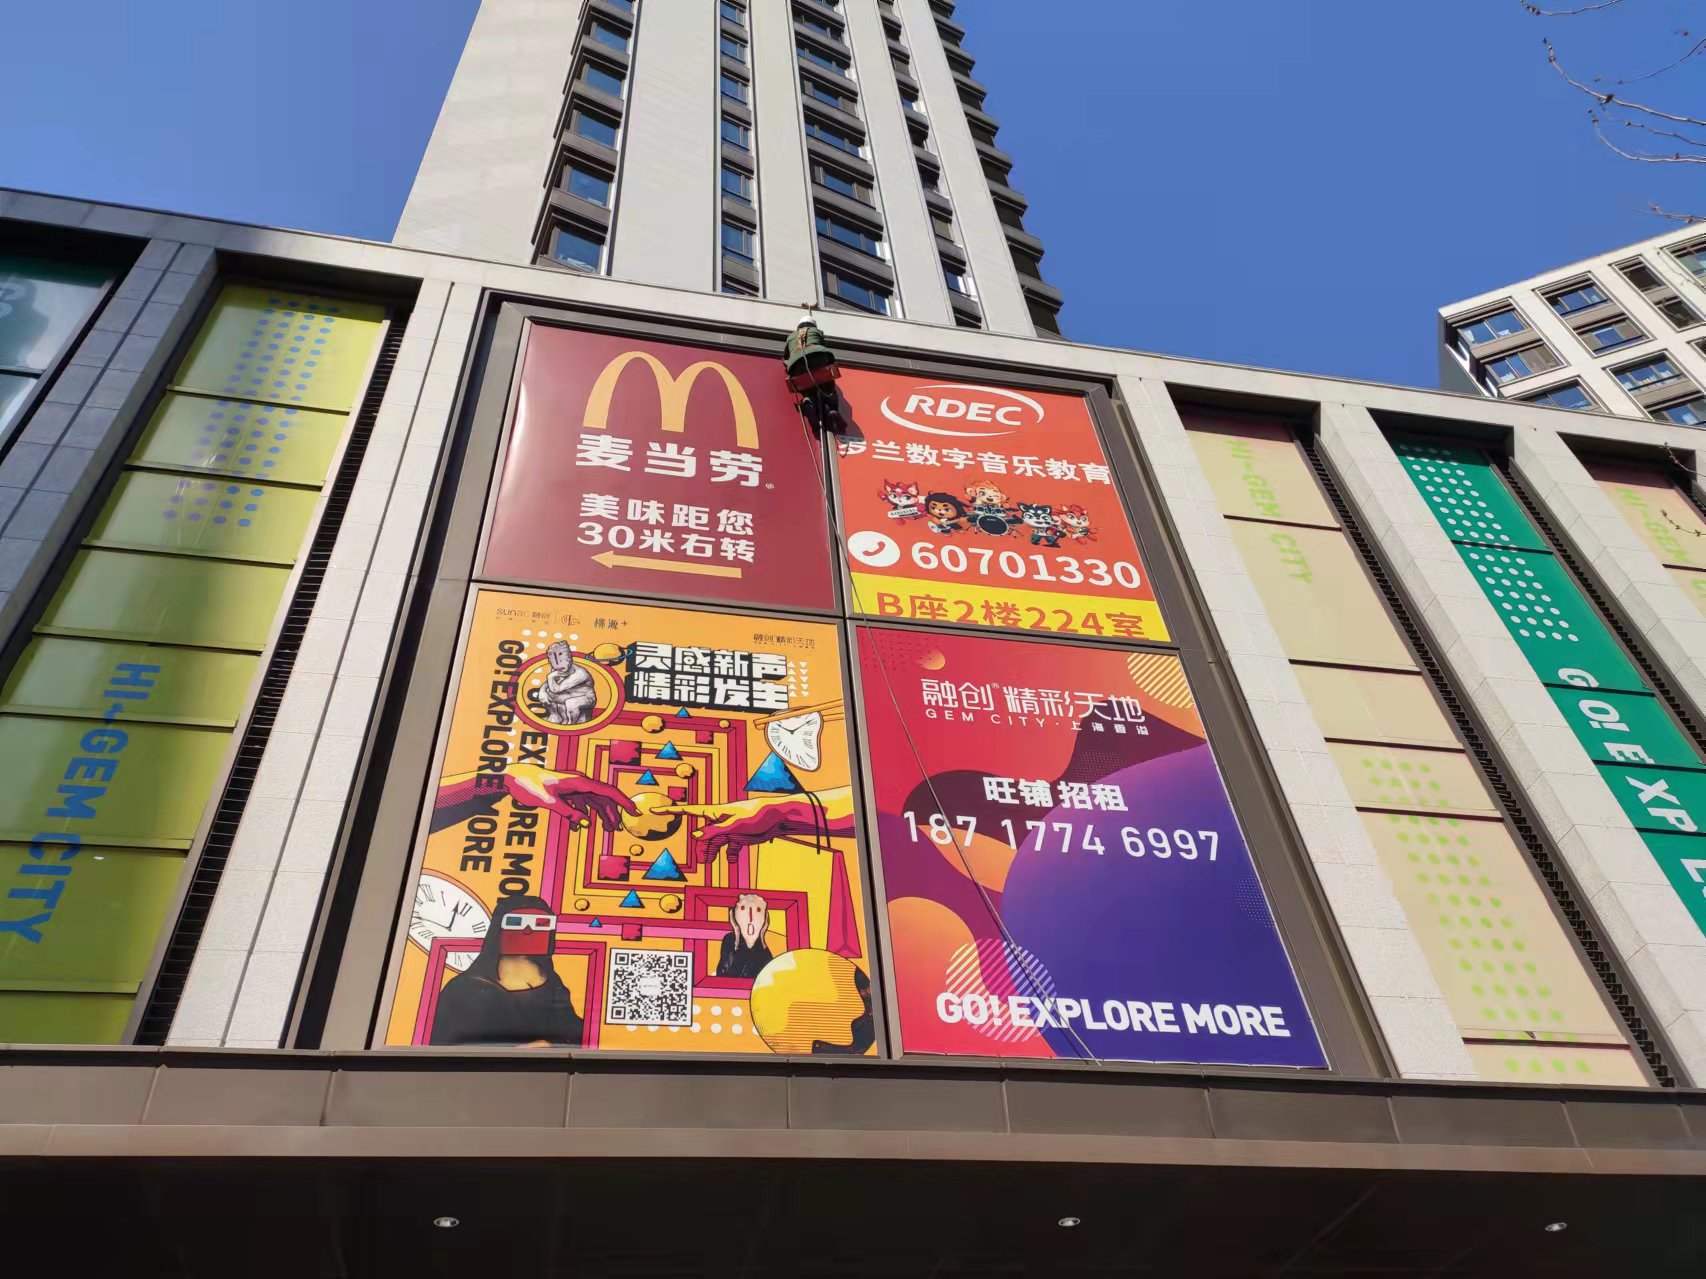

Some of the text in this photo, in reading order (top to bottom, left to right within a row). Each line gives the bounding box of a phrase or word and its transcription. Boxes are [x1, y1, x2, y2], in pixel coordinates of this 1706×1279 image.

[903, 394, 1023, 426] RDEC
[575, 433, 763, 487] 麦当劳
[579, 493, 754, 535] 美味距您
[577, 522, 755, 563] 30米右转
[911, 542, 1141, 589] 60701330
[877, 592, 1150, 640] B座2楼224室
[494, 640, 525, 678] GO!
[635, 641, 788, 680] 灵感新声
[475, 680, 519, 790] EXPLORE
[925, 708, 1046, 728] GEM CITY
[1558, 667, 1706, 898] GO! EXPL
[903, 811, 1219, 862] 187 1774 6997
[0, 832, 81, 944] CITY
[936, 992, 1291, 1037] GO! EXPLORE MORE
